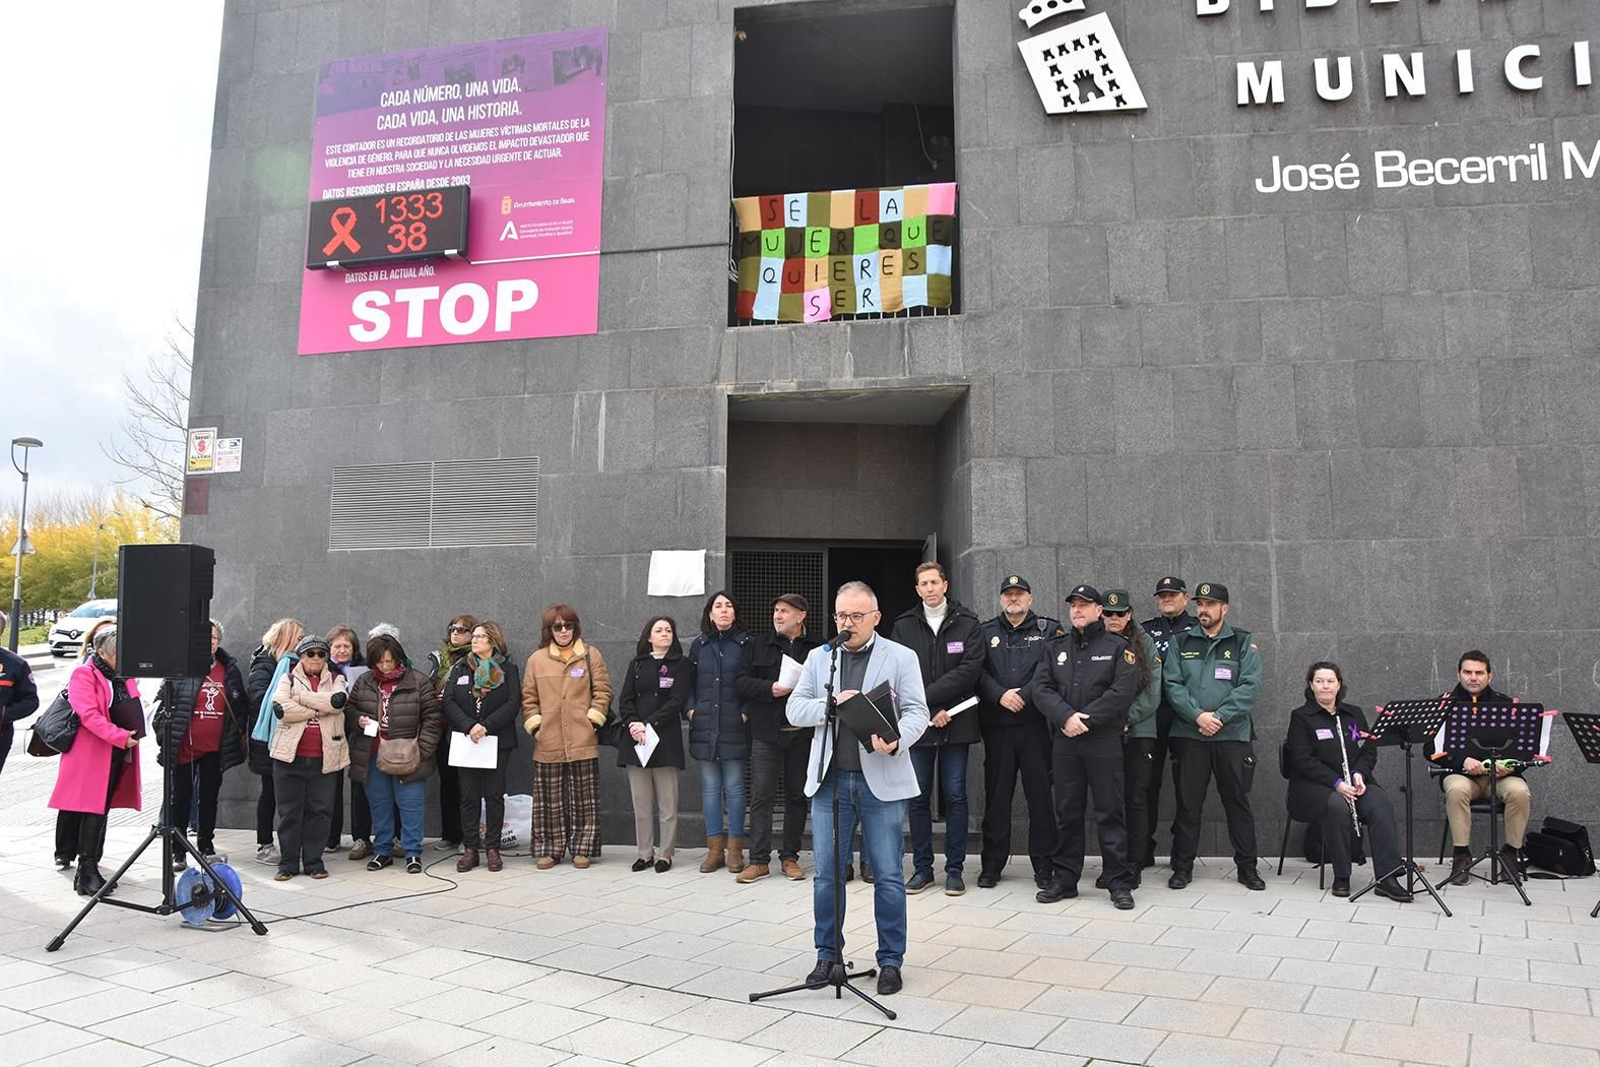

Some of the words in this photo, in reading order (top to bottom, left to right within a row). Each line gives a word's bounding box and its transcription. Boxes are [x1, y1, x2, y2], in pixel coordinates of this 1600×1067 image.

[1235, 40, 1592, 105] MUNICI
[380, 91, 411, 108] CADA
[413, 85, 462, 104] NÚMERO,
[465, 81, 489, 98] UNA
[492, 77, 522, 95] VIDA.
[376, 113, 407, 130] CADA
[410, 109, 439, 127] VIDA,
[441, 106, 465, 123] UNA
[467, 100, 522, 120] HISTORIA.
[325, 156, 357, 168] VIOLENCIA
[358, 155, 367, 165] DE
[368, 152, 394, 164] GÉNERO,
[395, 151, 412, 160] PARA
[413, 149, 426, 159] QUE
[427, 147, 450, 157] NUNCA
[451, 142, 488, 154] OLVIDEMOS
[489, 141, 498, 150] EL
[498, 138, 528, 150] IMPACTO
[529, 133, 574, 146] DEVASTADOR
[576, 131, 590, 141] QUE
[326, 145, 342, 155] ESTE
[342, 141, 376, 153] CONTADOR
[377, 140, 386, 149] ES
[386, 139, 396, 148] UN
[396, 133, 445, 147] RECORDATORIO
[445, 132, 454, 141] DE
[455, 131, 468, 140] LAS
[468, 127, 499, 140] MUJERES
[500, 124, 532, 136] VÍCTIMAS
[533, 120, 569, 133] MORTALES
[570, 119, 580, 129] DE
[580, 118, 590, 127] LA
[348, 168, 365, 179] TIENE
[366, 167, 375, 177] EN
[376, 164, 405, 176] NUESTRA
[406, 160, 438, 172] SOCIEDAD
[439, 159, 444, 169] Y
[444, 158, 453, 168] LA
[454, 154, 491, 167] NECESIDAD
[492, 151, 522, 164] URGENTE
[523, 150, 533, 160] DE
[533, 147, 562, 159] ACTUAR.
[1255, 152, 1360, 193] José
[1374, 142, 1548, 188] Becerril
[322, 188, 345, 200] DATOS
[346, 183, 385, 196] RECOGIDOS
[386, 182, 396, 192] EN
[396, 178, 425, 191] ESPAÑA
[426, 177, 449, 188] DESDE
[451, 175, 471, 186] 2003
[375, 192, 444, 224] 1333
[860, 198, 898, 220] LA
[386, 221, 428, 253] 38
[741, 229, 847, 255] MUJER
[884, 220, 944, 242] QUE
[345, 271, 368, 283] DATOS
[368, 270, 379, 281] EN
[380, 269, 388, 280] EL
[389, 267, 417, 279] ACTUAL
[418, 265, 436, 277] AÑO.
[762, 252, 919, 284] QUIERES
[348, 278, 539, 343] STOP
[810, 288, 874, 316] SER
